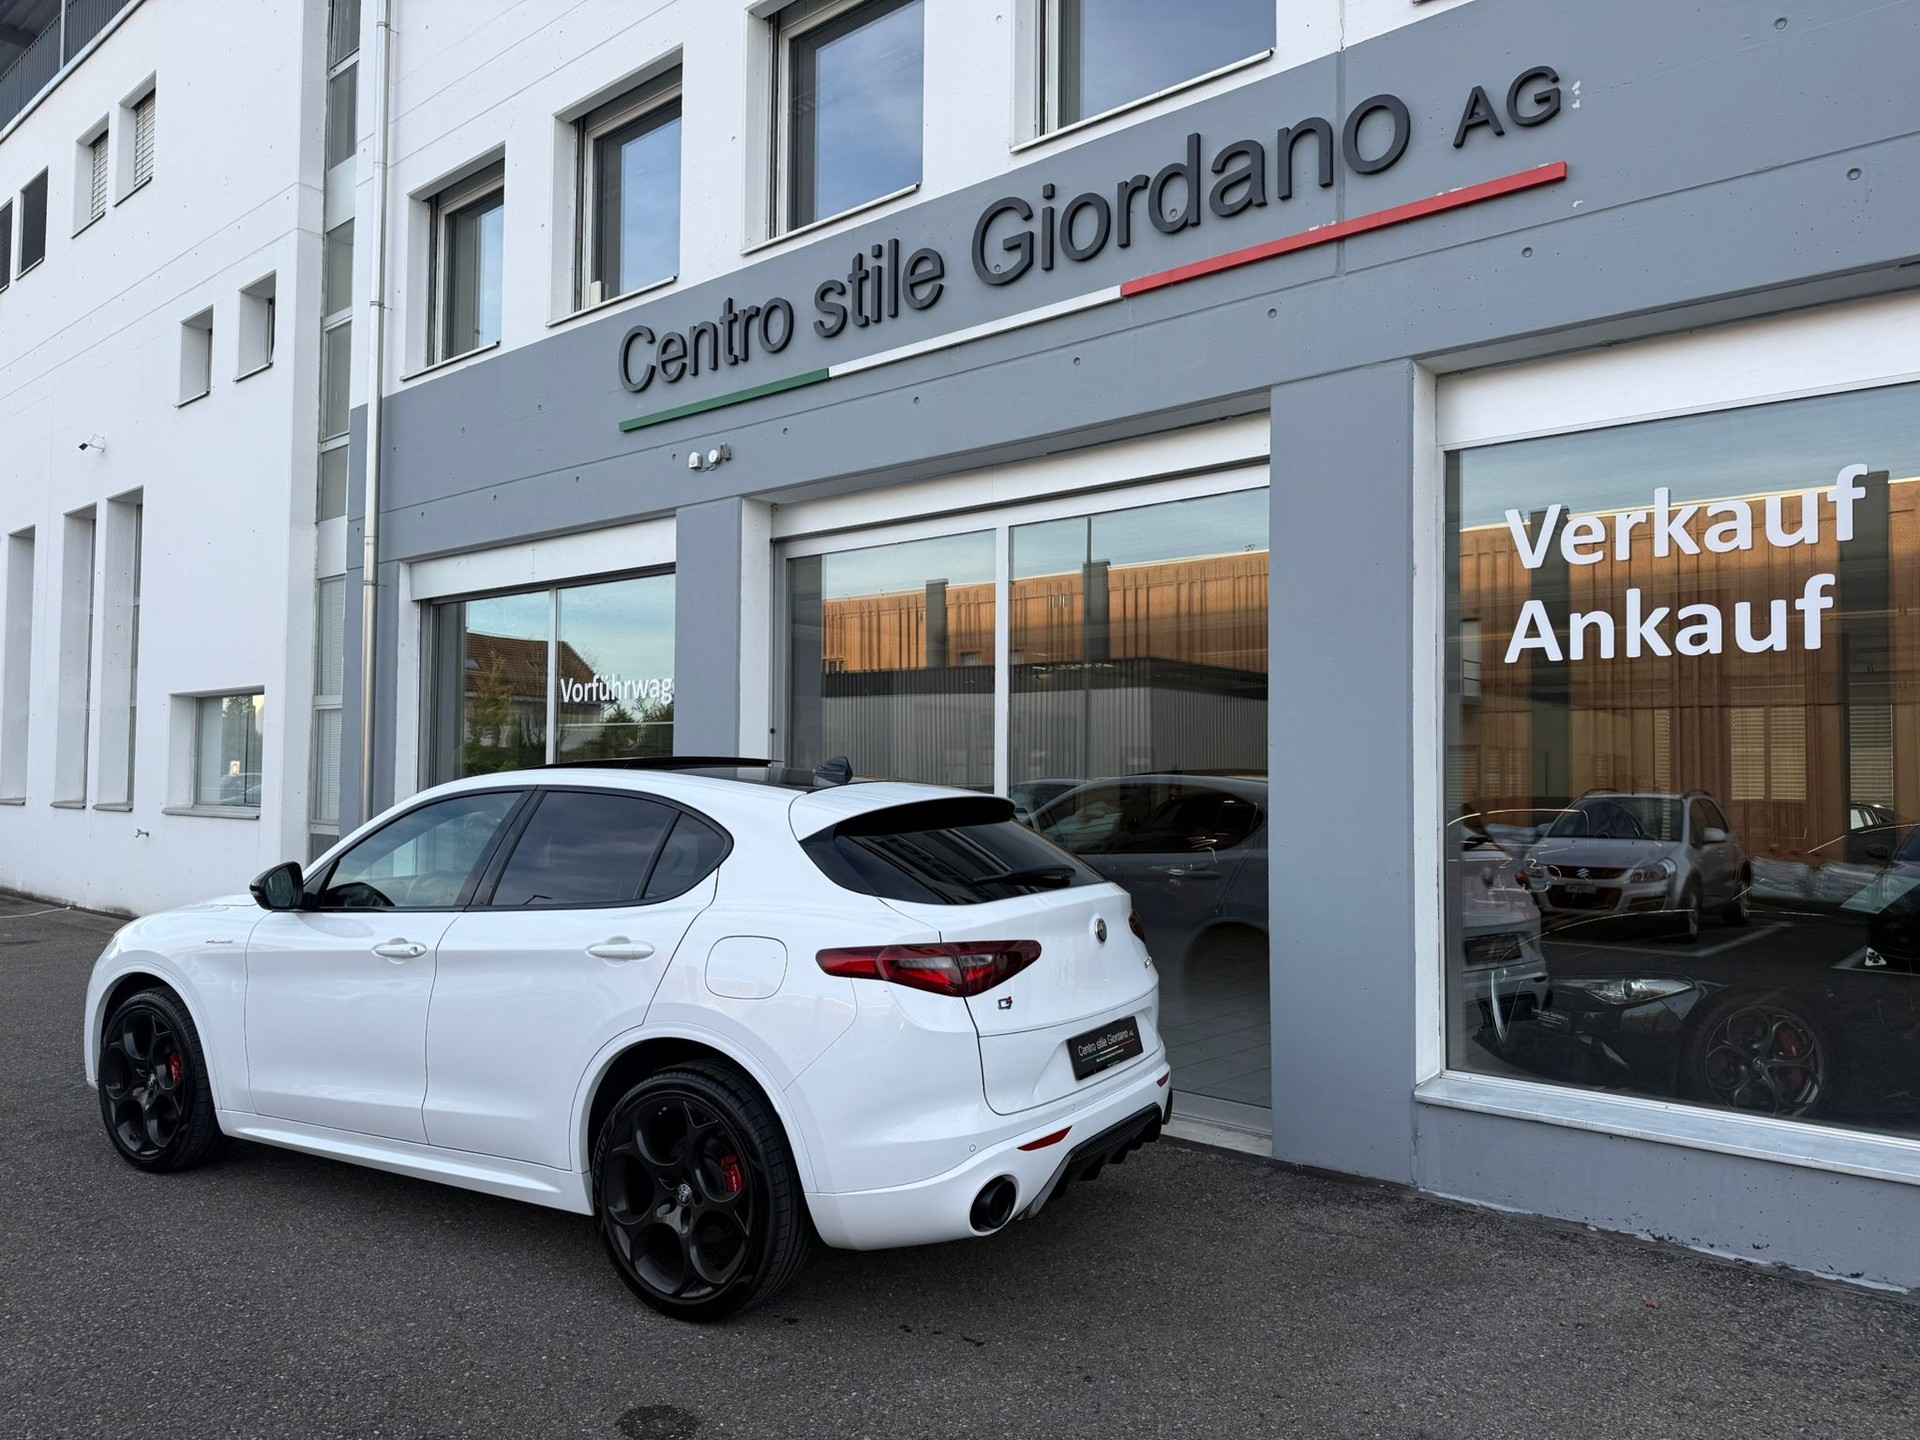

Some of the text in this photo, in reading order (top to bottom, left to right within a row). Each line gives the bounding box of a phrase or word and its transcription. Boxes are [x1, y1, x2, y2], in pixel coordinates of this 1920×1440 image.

[618, 66, 1562, 393] Centro stile Giordano AG
[1504, 463, 1868, 569] Verkauf
[1504, 573, 1836, 664] Ankauf
[560, 673, 675, 705] Vorführwag
[1077, 1043, 1097, 1057] Centro
